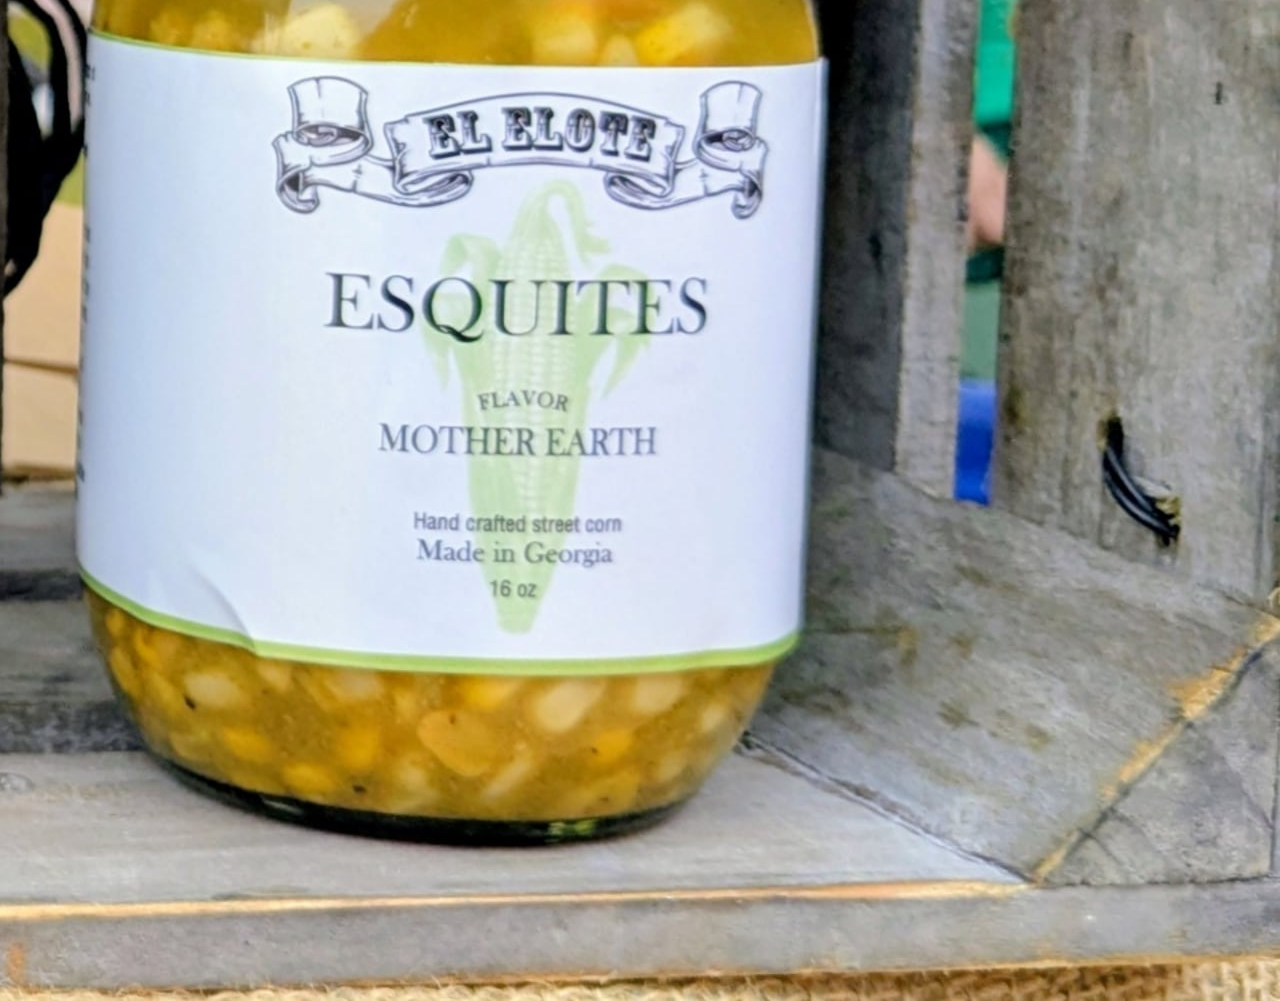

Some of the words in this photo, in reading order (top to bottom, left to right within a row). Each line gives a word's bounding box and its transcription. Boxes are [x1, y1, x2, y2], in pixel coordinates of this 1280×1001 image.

[425, 111, 493, 159] EL
[501, 107, 656, 162] ELOTE
[324, 271, 710, 343] ESQUITES
[477, 389, 570, 413] FLAVOR
[378, 421, 538, 457] MOTHER
[544, 426, 657, 456] EARTH
[412, 511, 461, 532] Hand
[465, 511, 527, 533] crafted
[531, 511, 581, 533] street
[584, 512, 623, 534] corn
[416, 538, 486, 564] Made
[492, 538, 517, 564] in
[522, 538, 614, 568] Georgia
[488, 580, 512, 599] 16
[515, 582, 538, 600] oz
